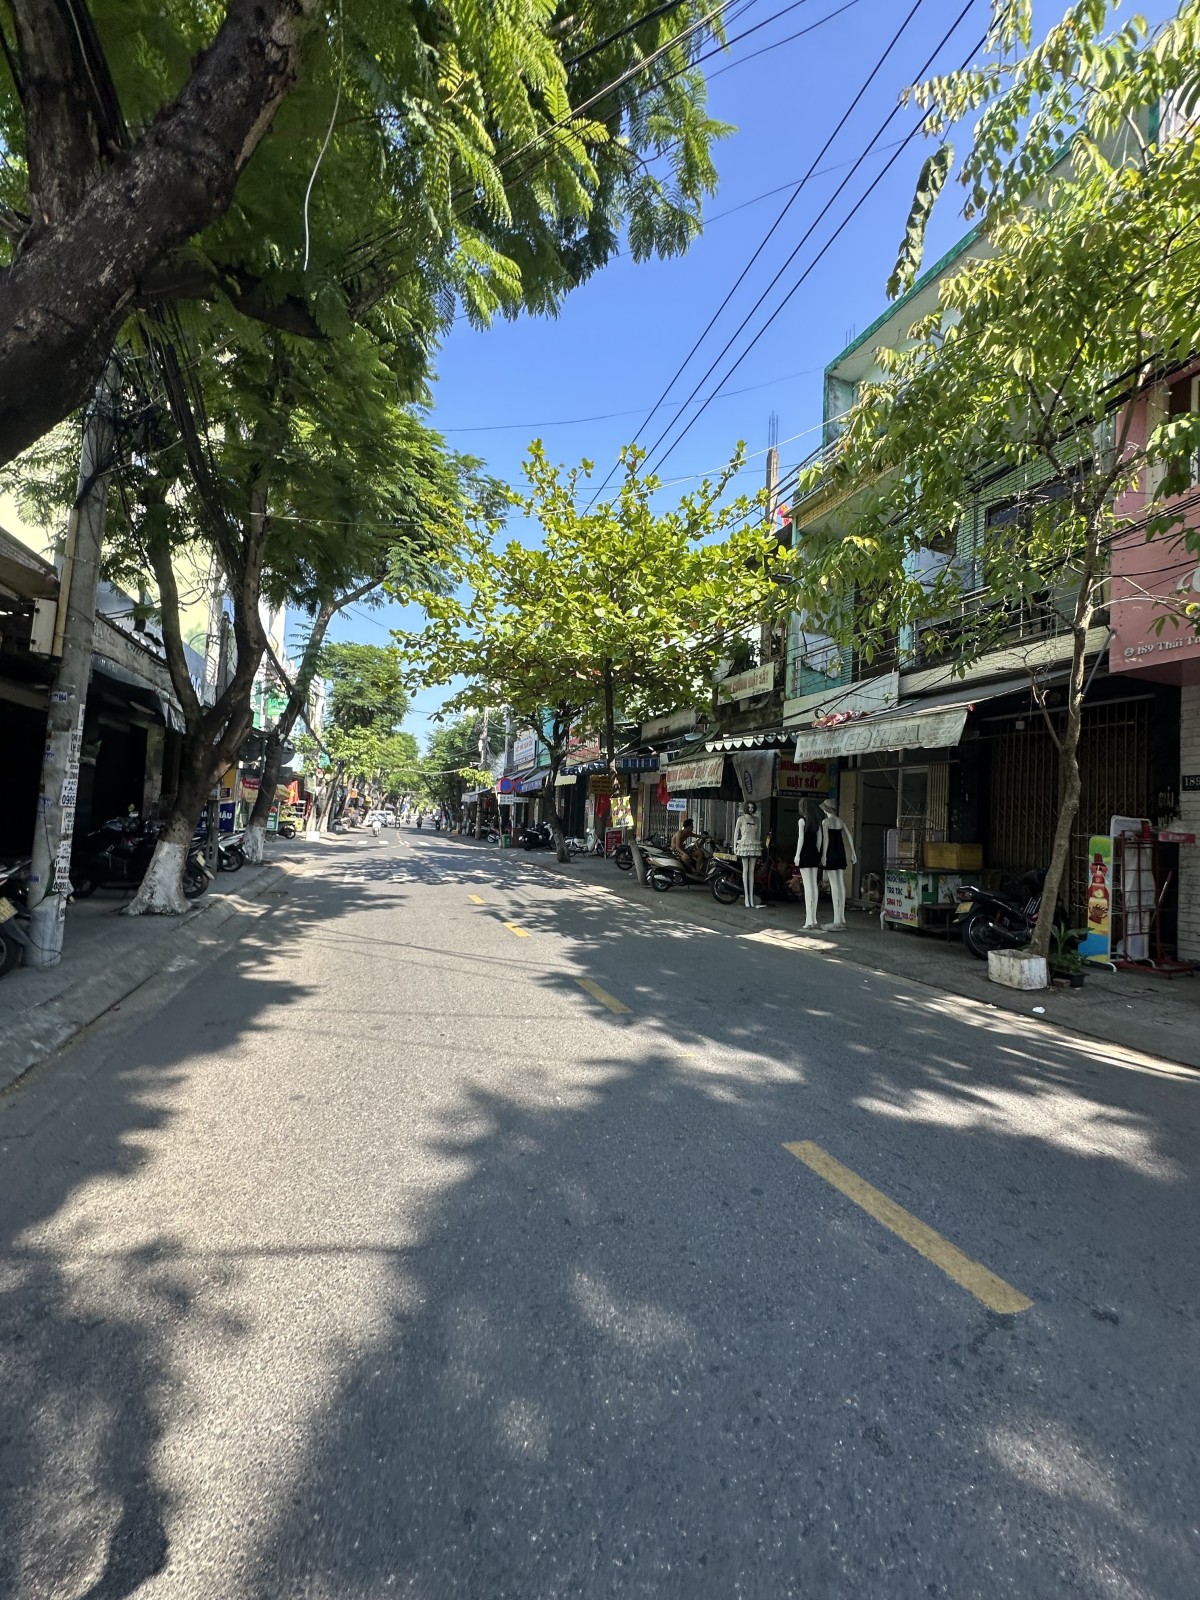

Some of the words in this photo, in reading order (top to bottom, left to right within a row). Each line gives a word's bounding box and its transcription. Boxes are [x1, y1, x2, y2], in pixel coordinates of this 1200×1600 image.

[1137, 644, 1154, 655] 189
[1157, 637, 1183, 651] Thái
[804, 775, 820, 789] SẤY
[1184, 777, 1200, 786] 189
